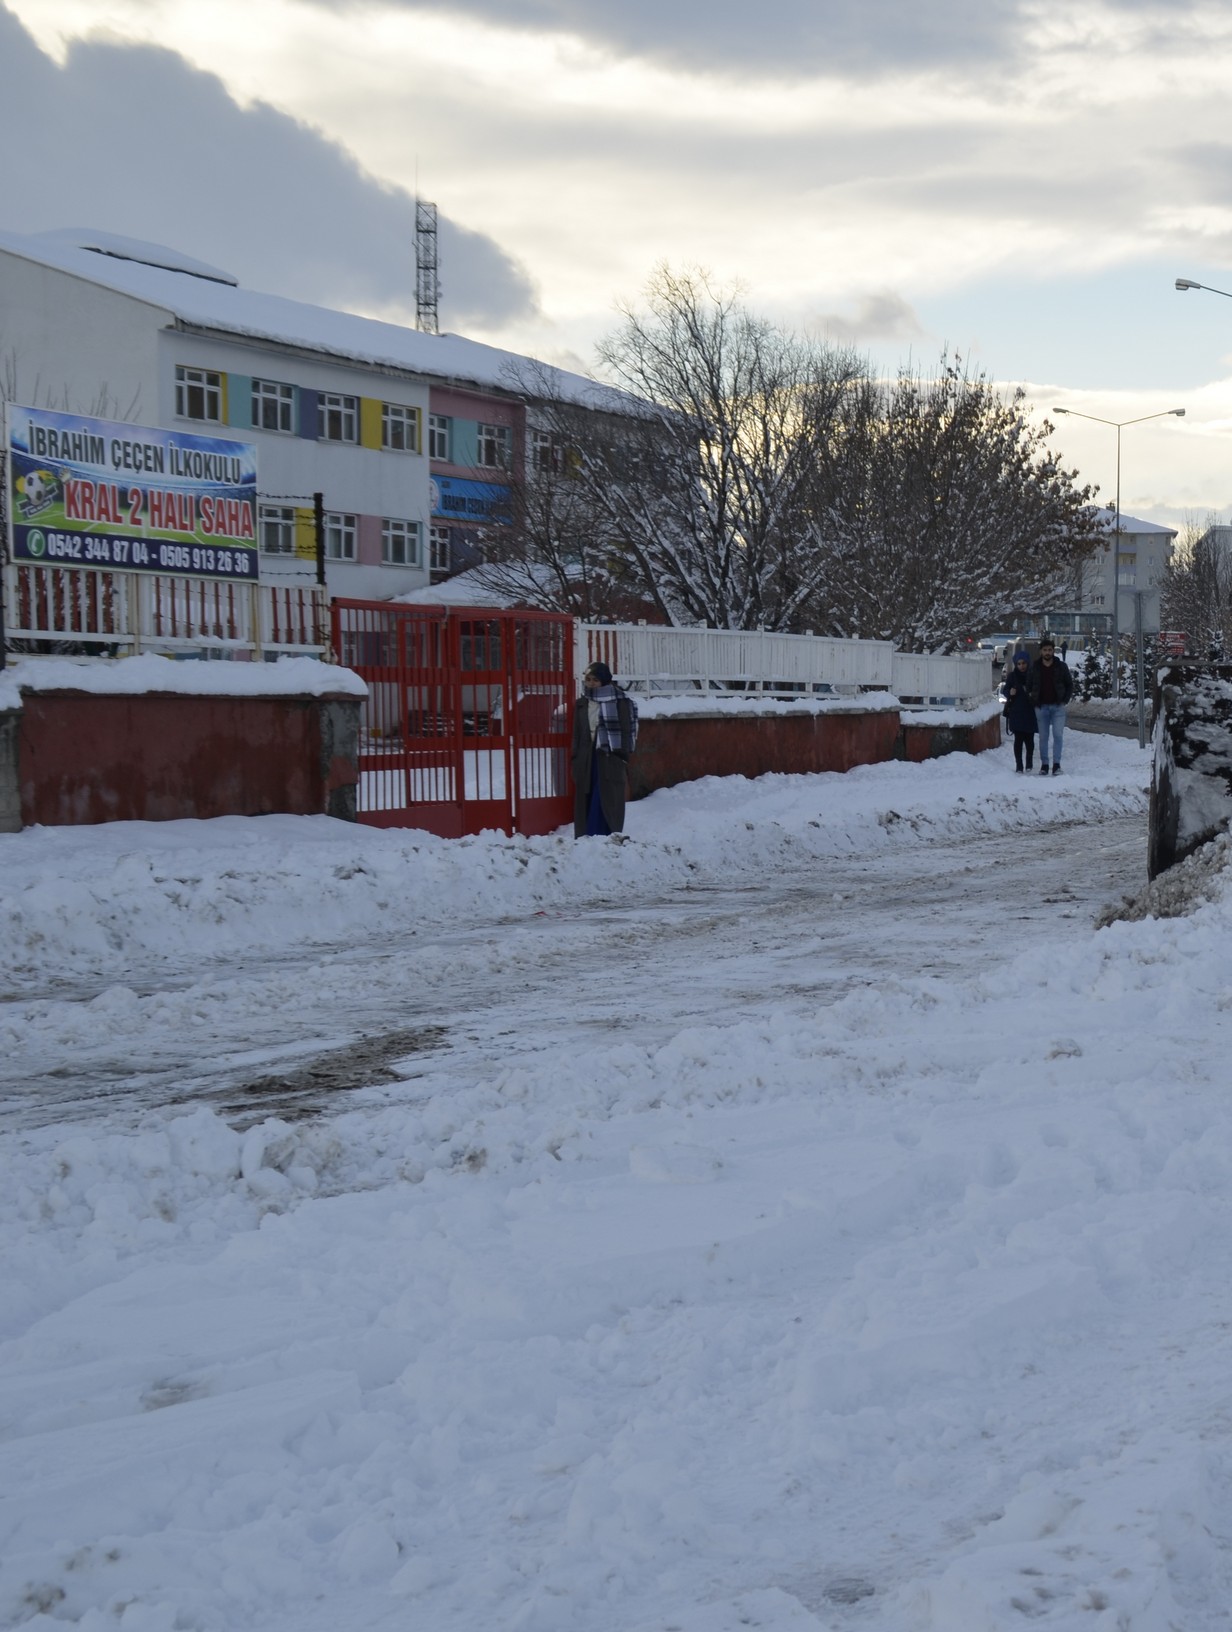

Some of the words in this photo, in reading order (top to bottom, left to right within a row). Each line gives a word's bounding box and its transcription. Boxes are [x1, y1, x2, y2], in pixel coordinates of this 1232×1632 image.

[28, 420, 105, 465] İBRAHİM
[111, 439, 164, 474] ÇEÇEN
[169, 441, 241, 485] İLKOKULU
[65, 479, 123, 524] KRAL
[128, 487, 143, 527] 2
[149, 490, 195, 532] HALI
[201, 497, 254, 539] SAHA
[48, 533, 82, 558] 0542
[85, 538, 110, 560] 344
[113, 540, 128, 561] 87
[132, 543, 149, 564] 04
[160, 545, 189, 568] 0505
[192, 549, 214, 569] 913
[218, 553, 232, 572] 26
[235, 555, 249, 573] 36
